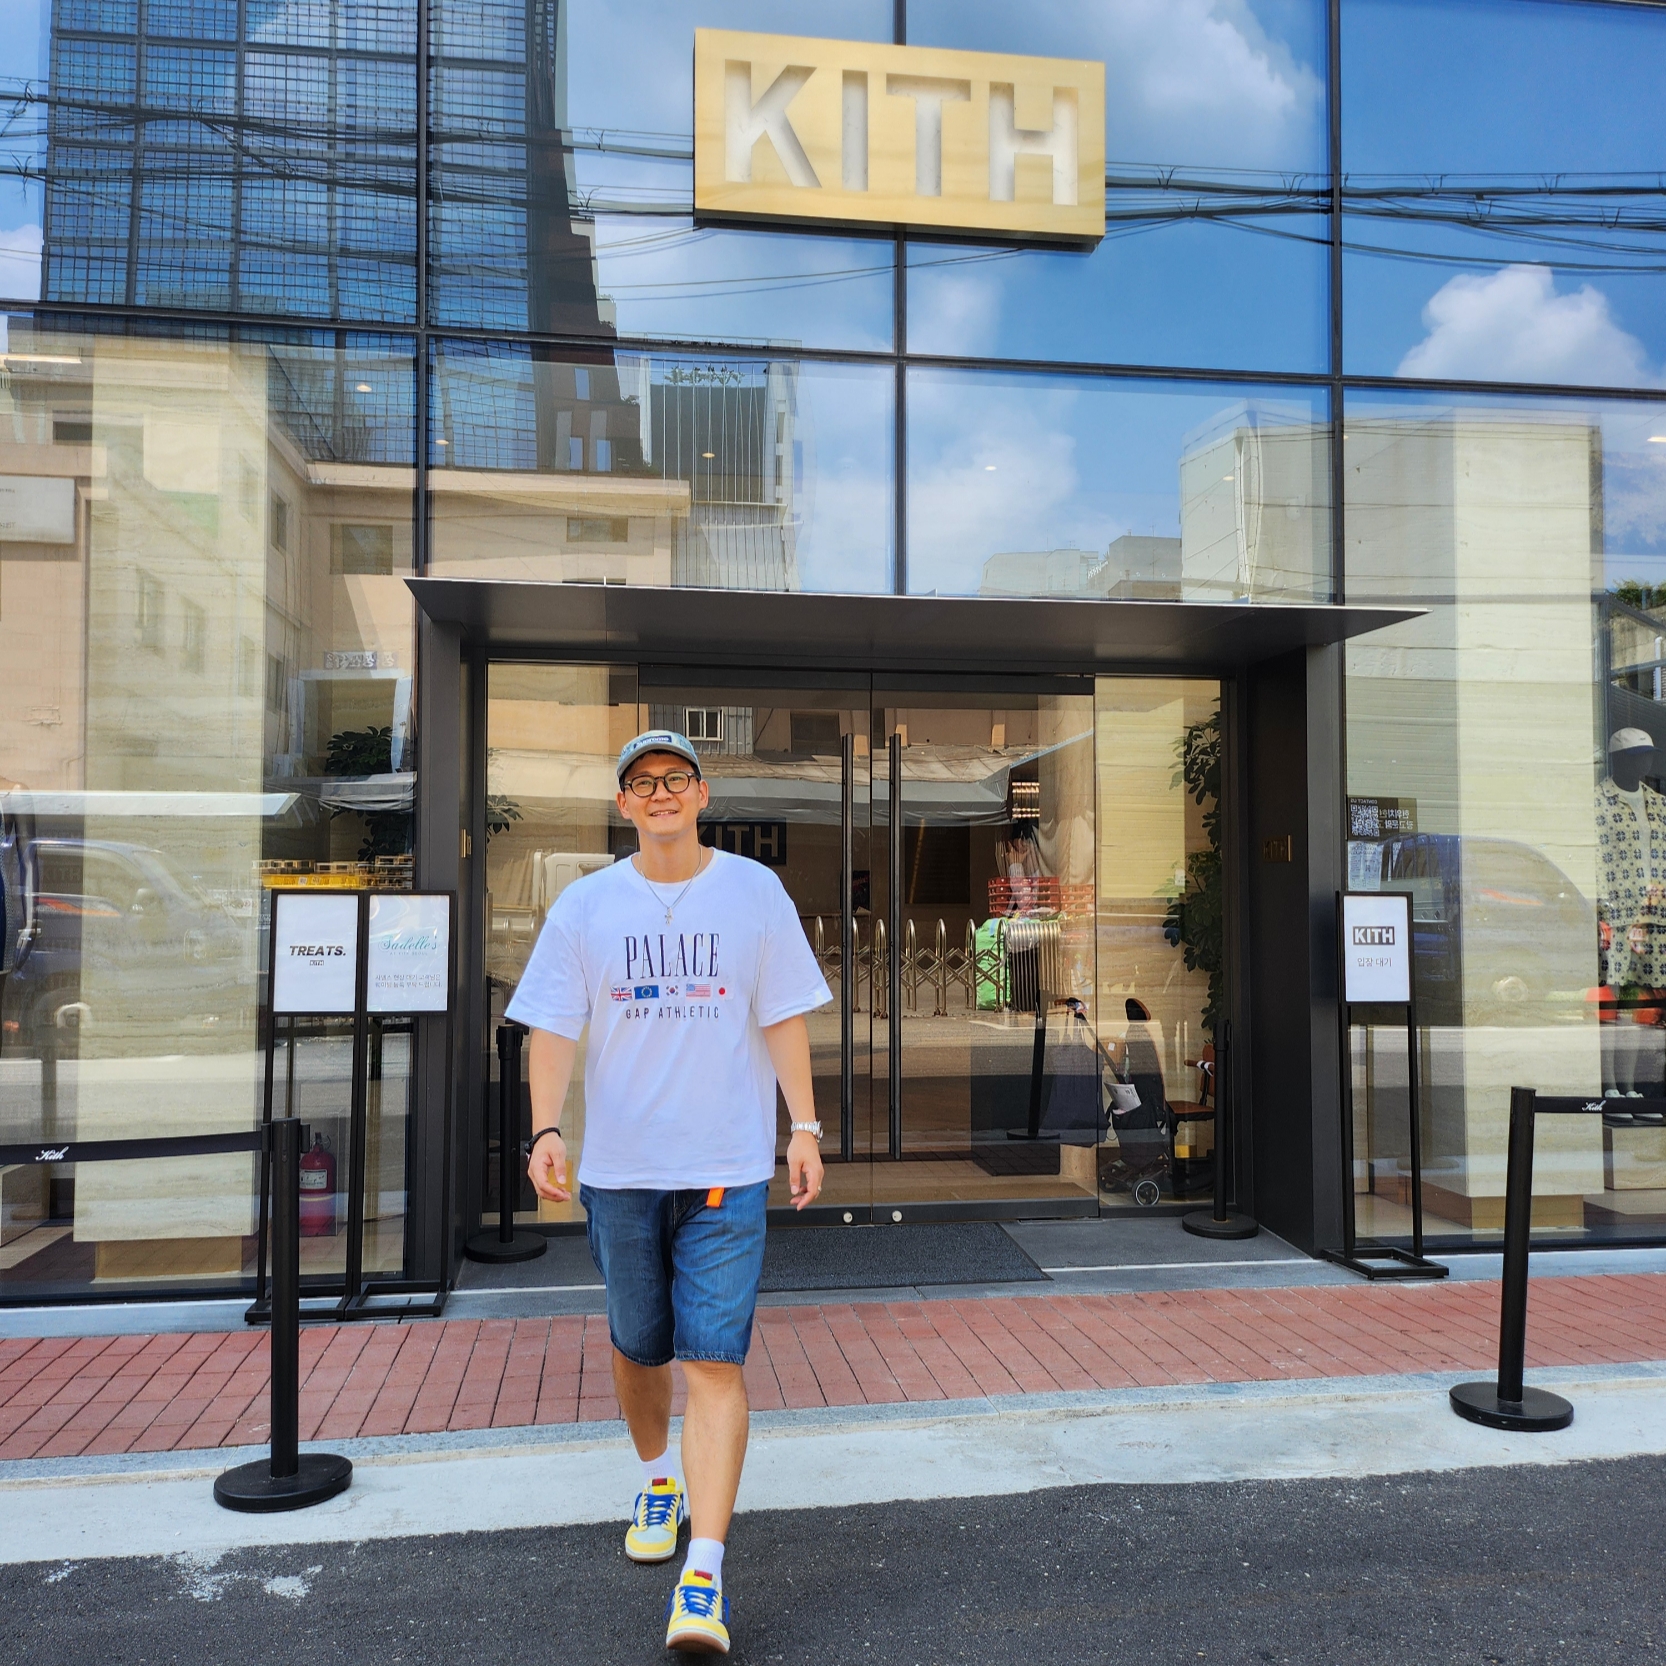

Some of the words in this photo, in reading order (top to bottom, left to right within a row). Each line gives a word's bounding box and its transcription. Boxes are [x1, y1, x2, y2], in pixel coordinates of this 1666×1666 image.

[725, 59, 1079, 206] KITH
[378, 934, 437, 952] Sadelle's
[1354, 928, 1394, 944] KITH
[289, 945, 346, 956] TREATS.
[624, 933, 720, 980] PALACE
[1357, 957, 1373, 967] 입장
[1375, 957, 1392, 967] 대기
[626, 1008, 649, 1019] GAP
[658, 1006, 720, 1018] ATHLETIC
[1582, 1100, 1607, 1111] Kith
[35, 1146, 70, 1161] Kith
